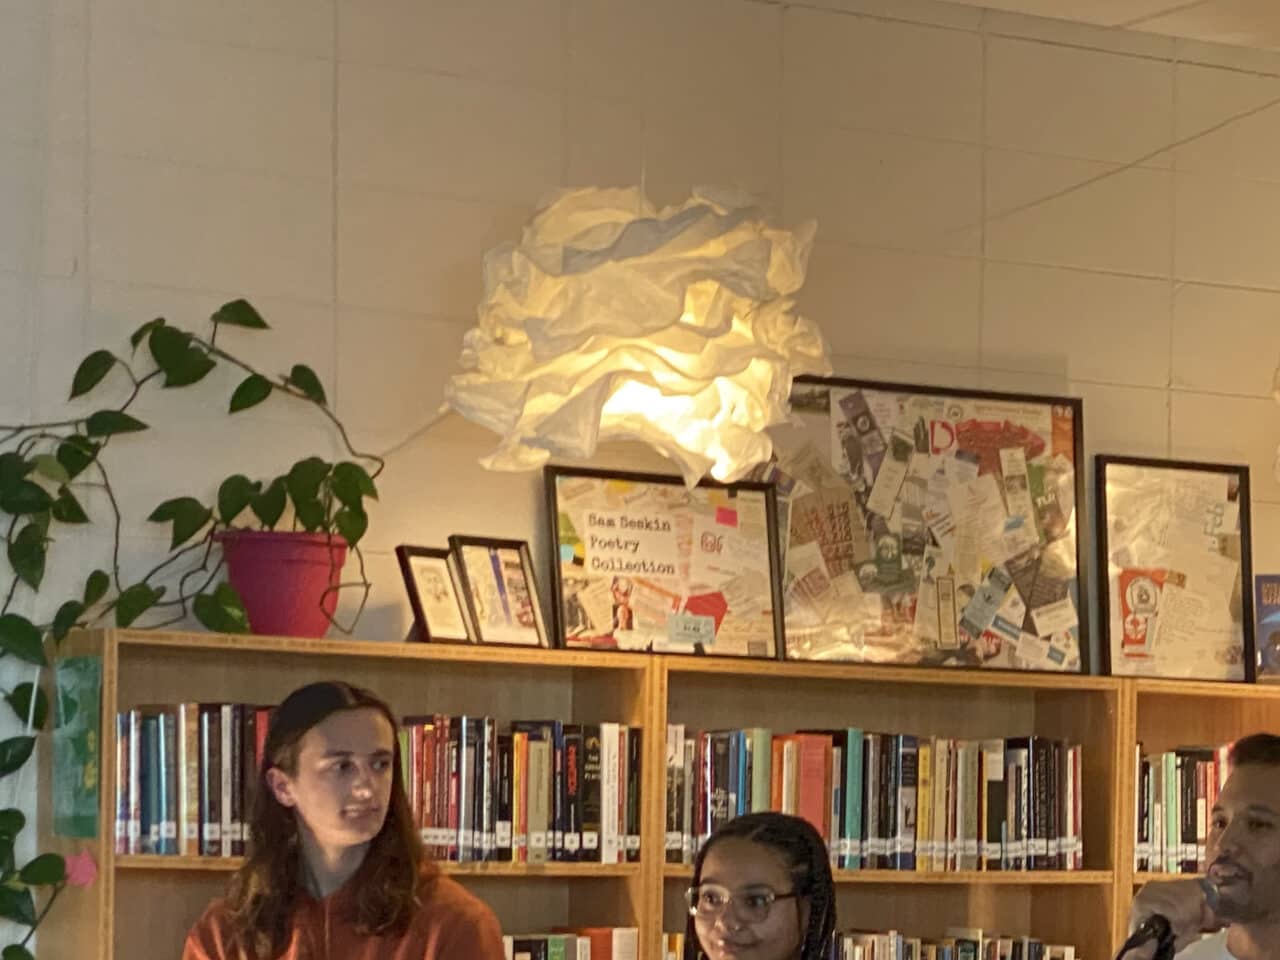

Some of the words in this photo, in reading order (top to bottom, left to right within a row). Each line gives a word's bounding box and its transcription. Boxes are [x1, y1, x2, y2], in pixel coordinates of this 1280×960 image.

[588, 513, 615, 527] Sam
[590, 536, 640, 553] Poetry
[591, 557, 676, 575] Collection
